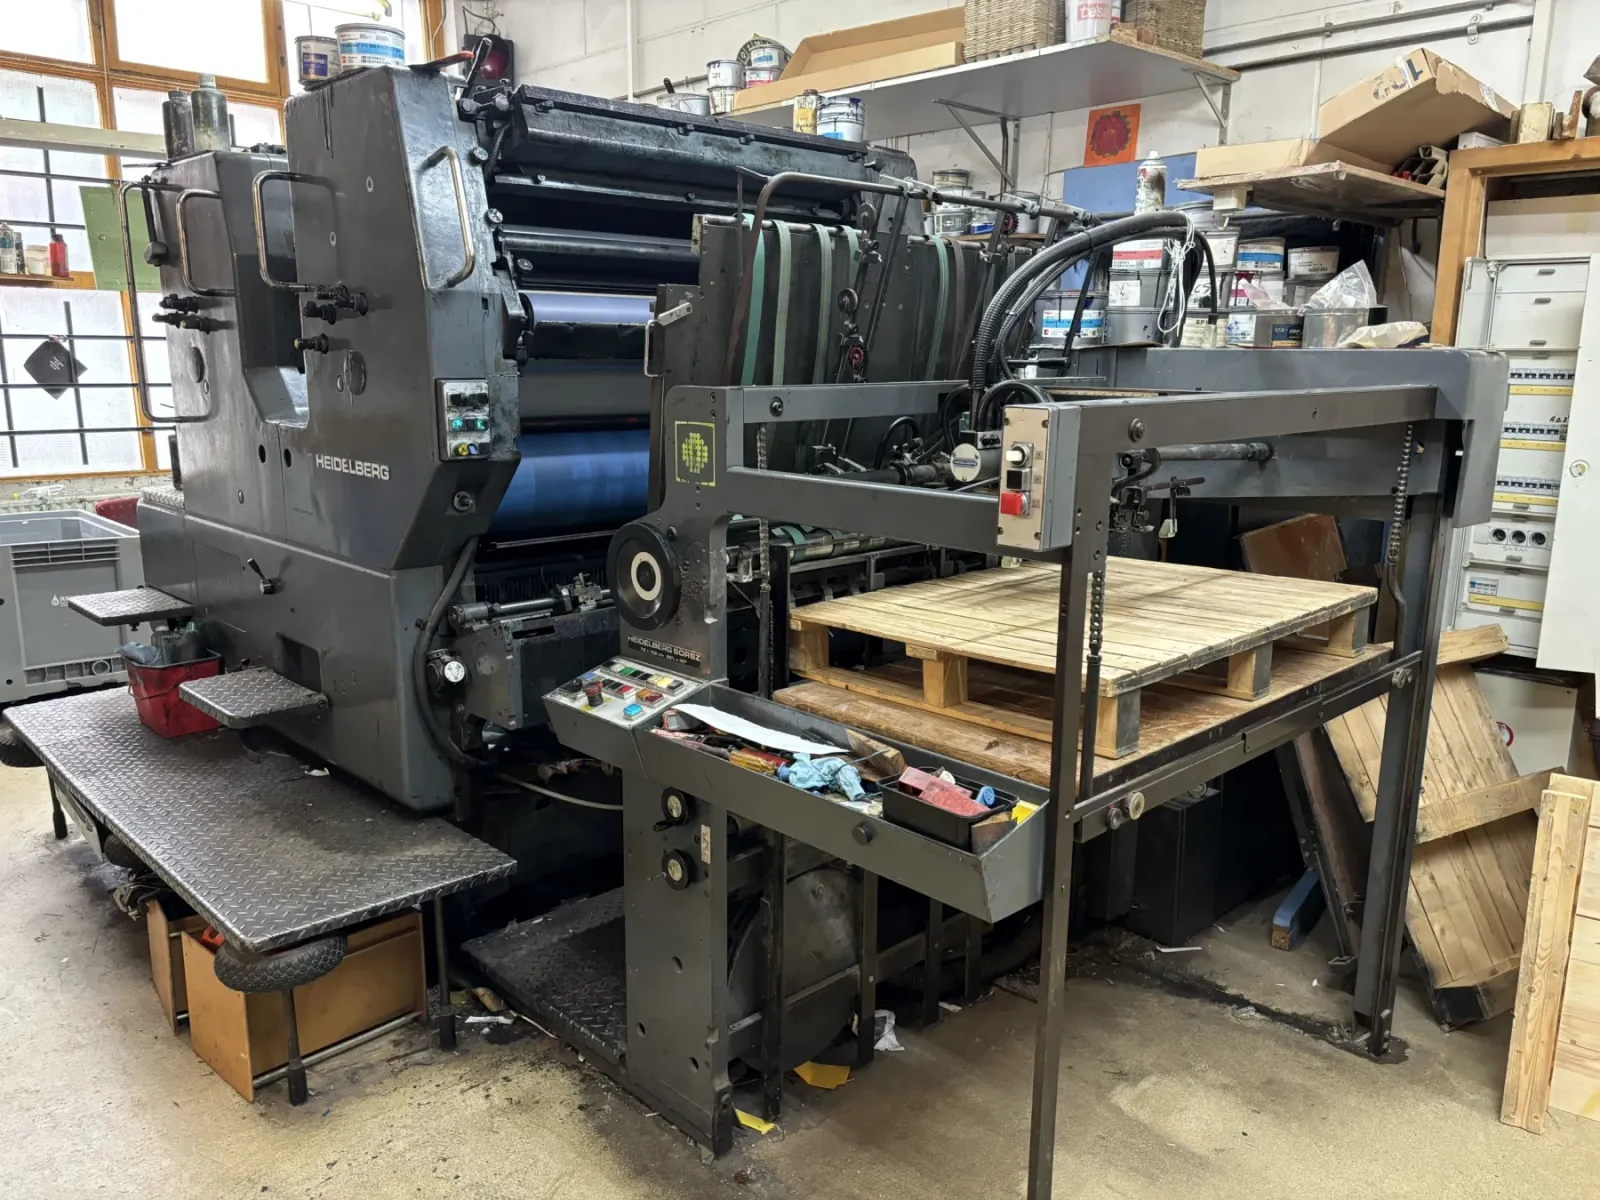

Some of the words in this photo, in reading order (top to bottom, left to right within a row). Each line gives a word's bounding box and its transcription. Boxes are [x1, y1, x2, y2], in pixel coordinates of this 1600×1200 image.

[315, 453, 390, 480] HEIDELBERG
[628, 635, 673, 653] HEIDELBERG
[673, 648, 701, 661] SORSZ
